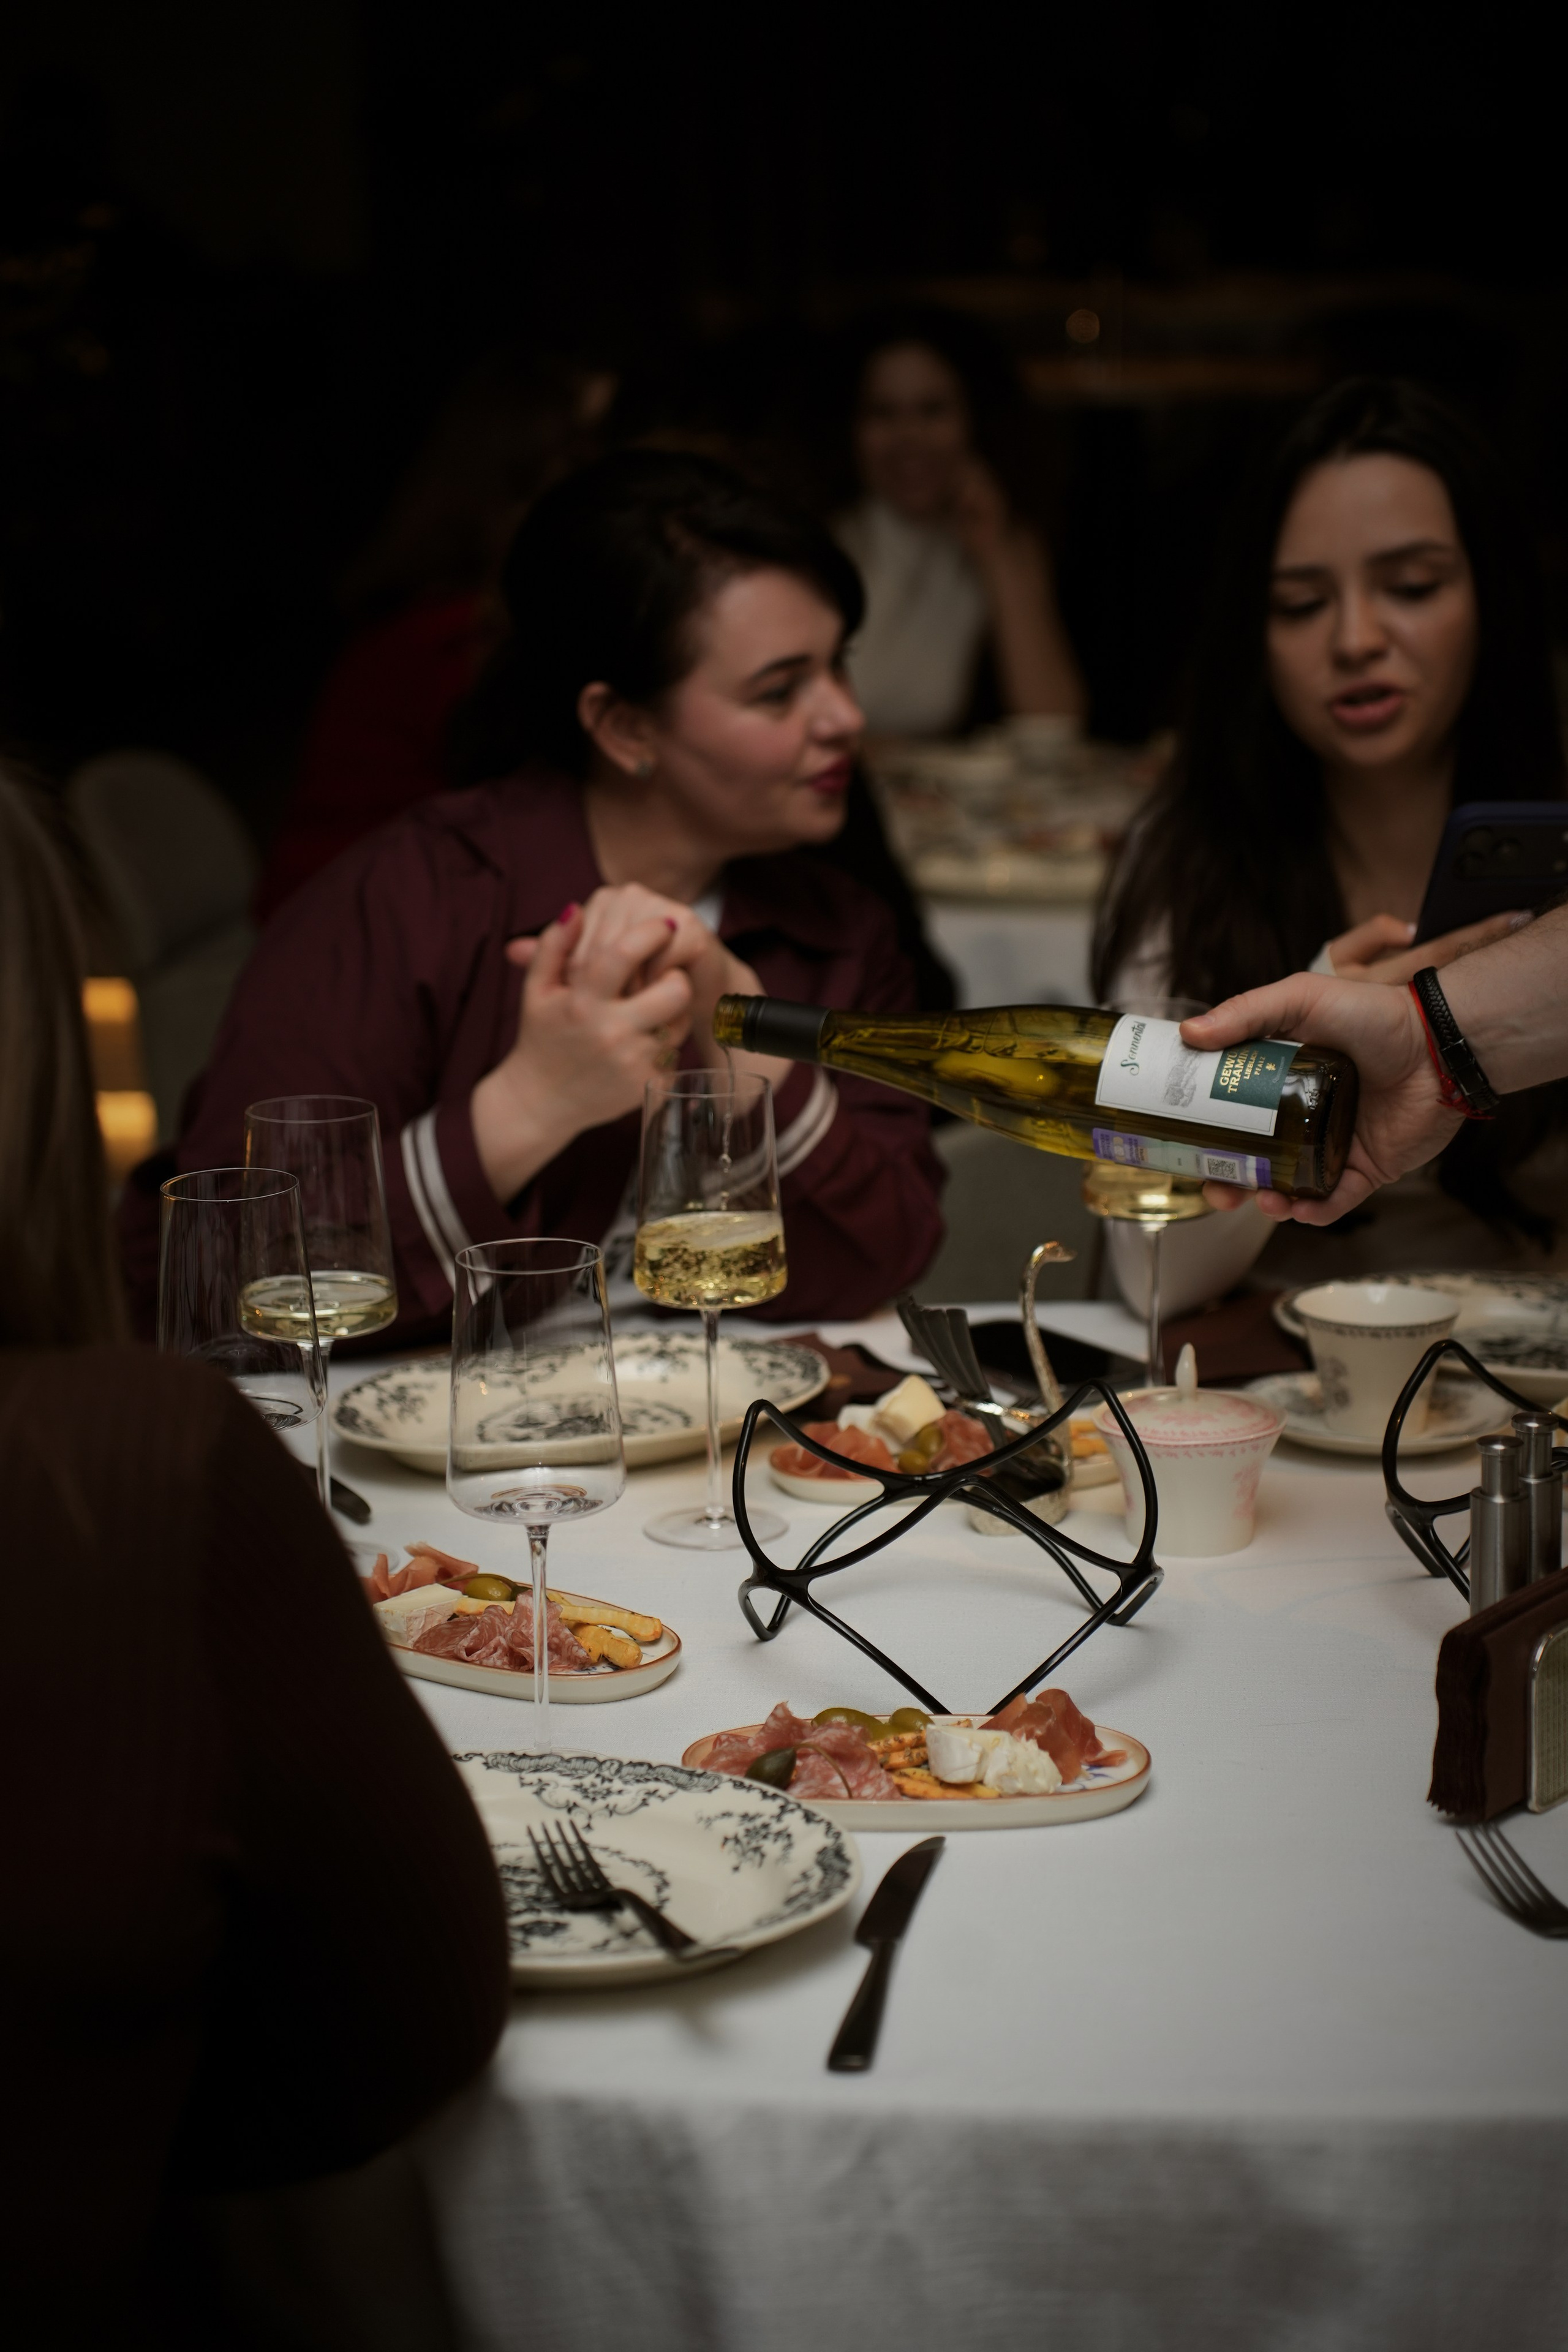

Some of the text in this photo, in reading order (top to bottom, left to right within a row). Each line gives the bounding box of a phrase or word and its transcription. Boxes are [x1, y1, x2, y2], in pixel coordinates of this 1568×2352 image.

[1120, 1020, 1147, 1076] Sonnental
[1243, 1050, 1259, 1080] LIEBLICH
[1254, 1056, 1265, 1076] PFALZ
